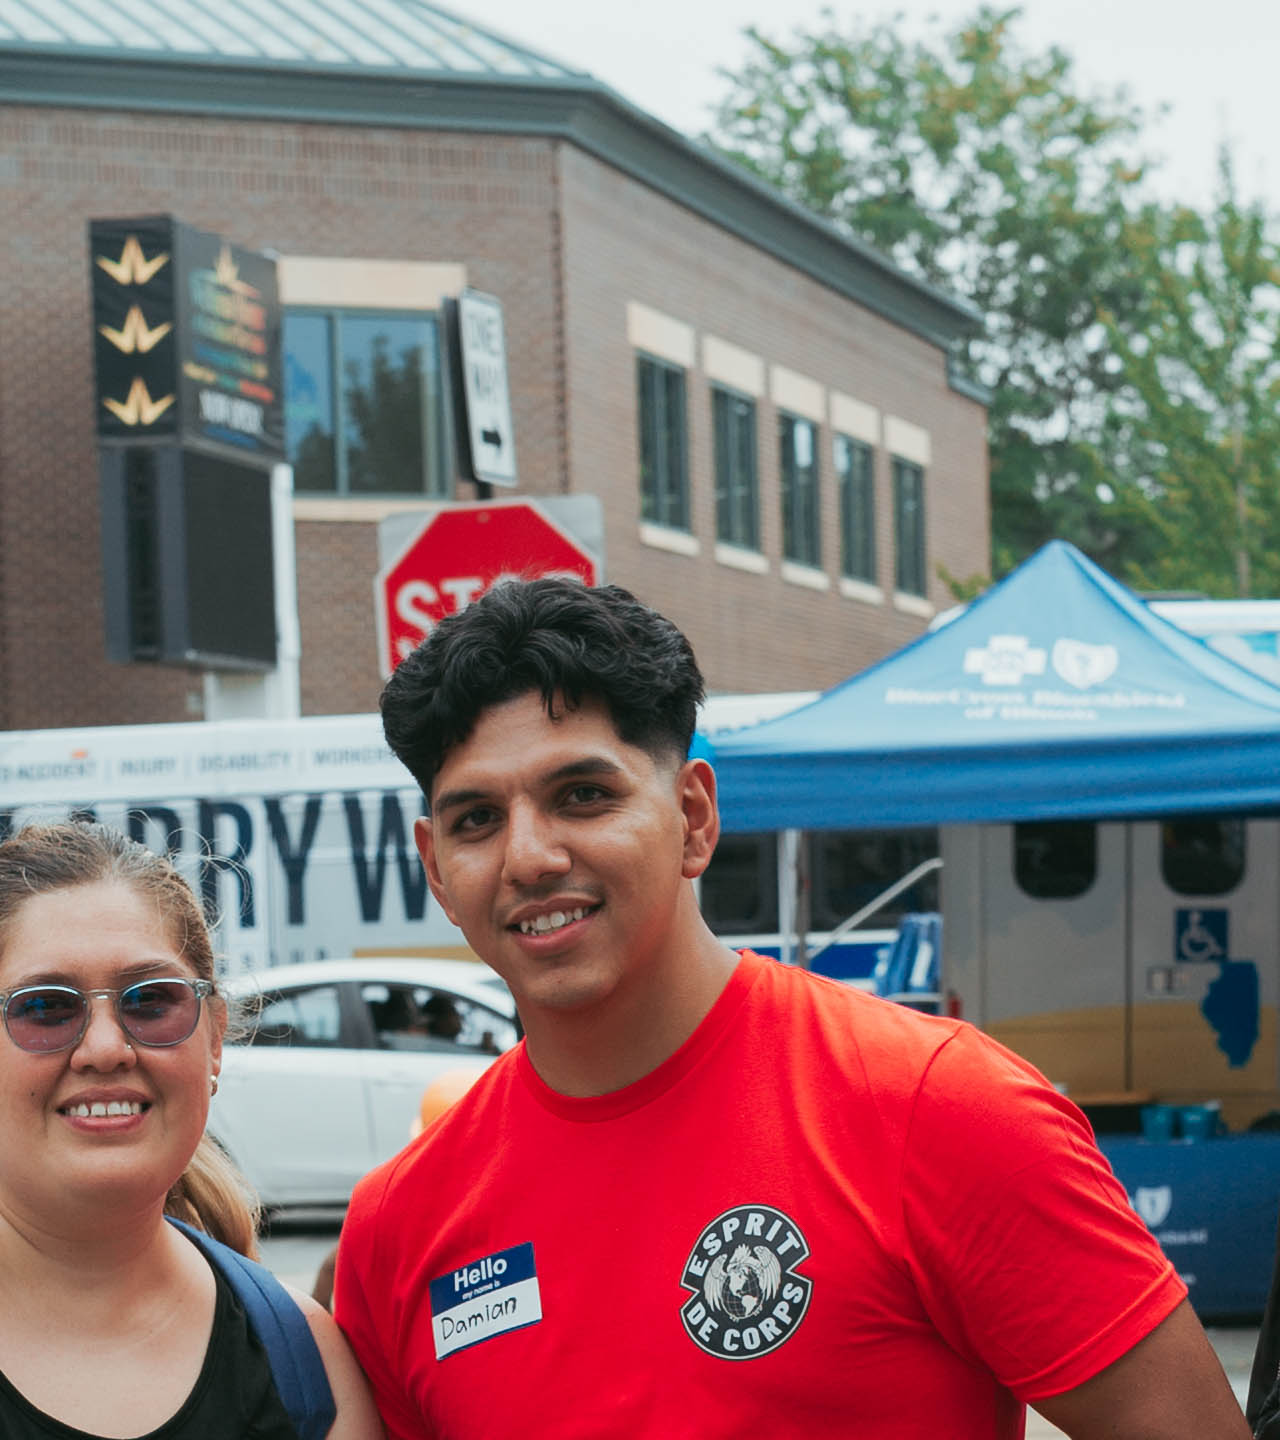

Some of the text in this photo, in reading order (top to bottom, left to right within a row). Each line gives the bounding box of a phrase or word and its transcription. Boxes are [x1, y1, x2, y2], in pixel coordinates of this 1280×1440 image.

[395, 570, 584, 660] ST
[688, 1212, 801, 1277] ESPRIT
[454, 1257, 508, 1292] Hello
[473, 1283, 493, 1296] name
[440, 1297, 518, 1340] Damian
[686, 1282, 804, 1352] DE CORPS
